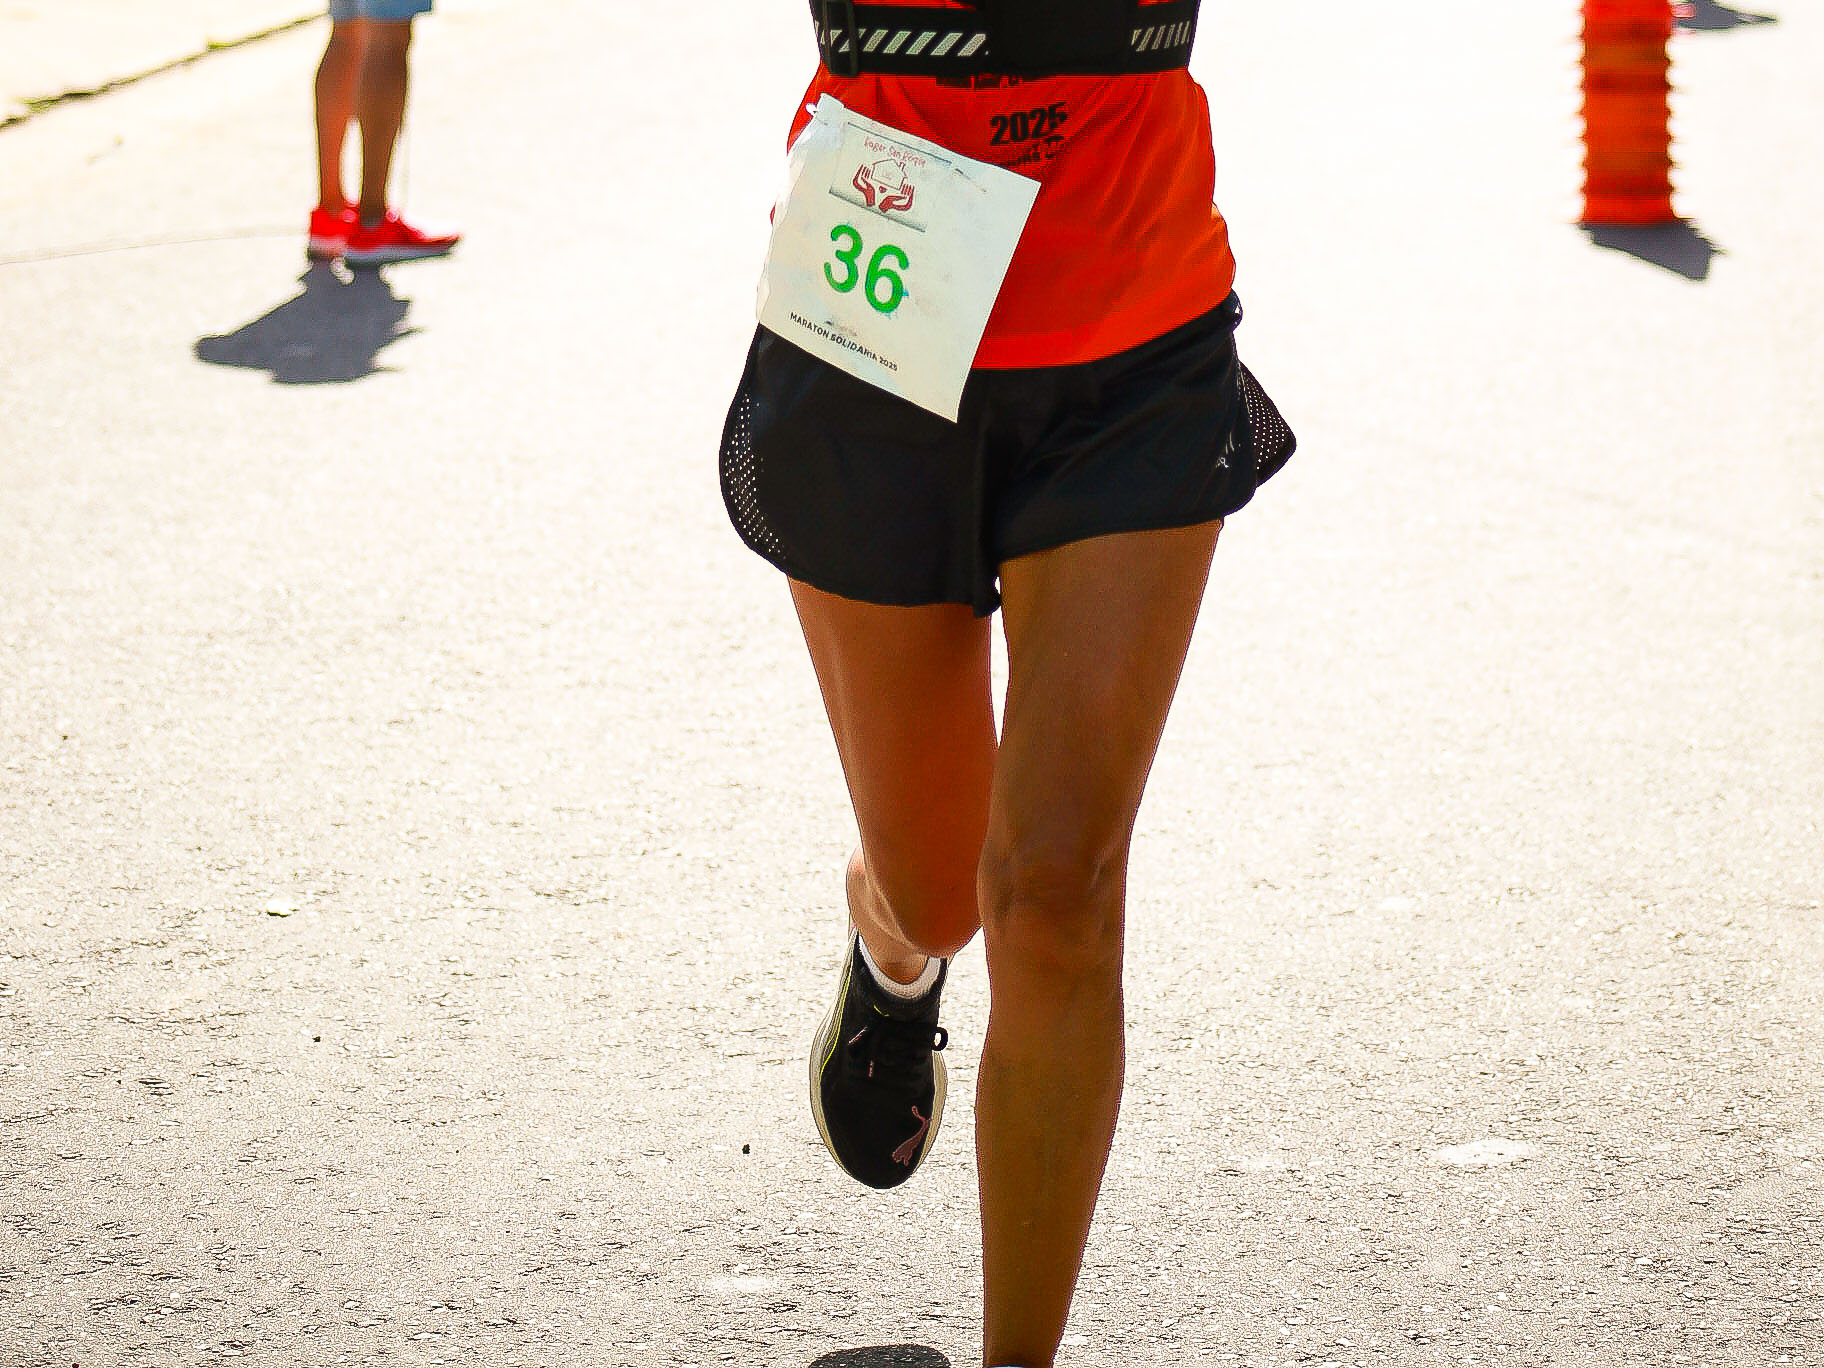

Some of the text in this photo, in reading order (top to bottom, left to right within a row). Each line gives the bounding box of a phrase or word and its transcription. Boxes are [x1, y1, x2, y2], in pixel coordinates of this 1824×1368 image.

[989, 101, 1068, 147] 2025
[824, 224, 910, 314] 36
[790, 311, 831, 339] MARATON
[830, 333, 878, 362] SOLIDARIA
